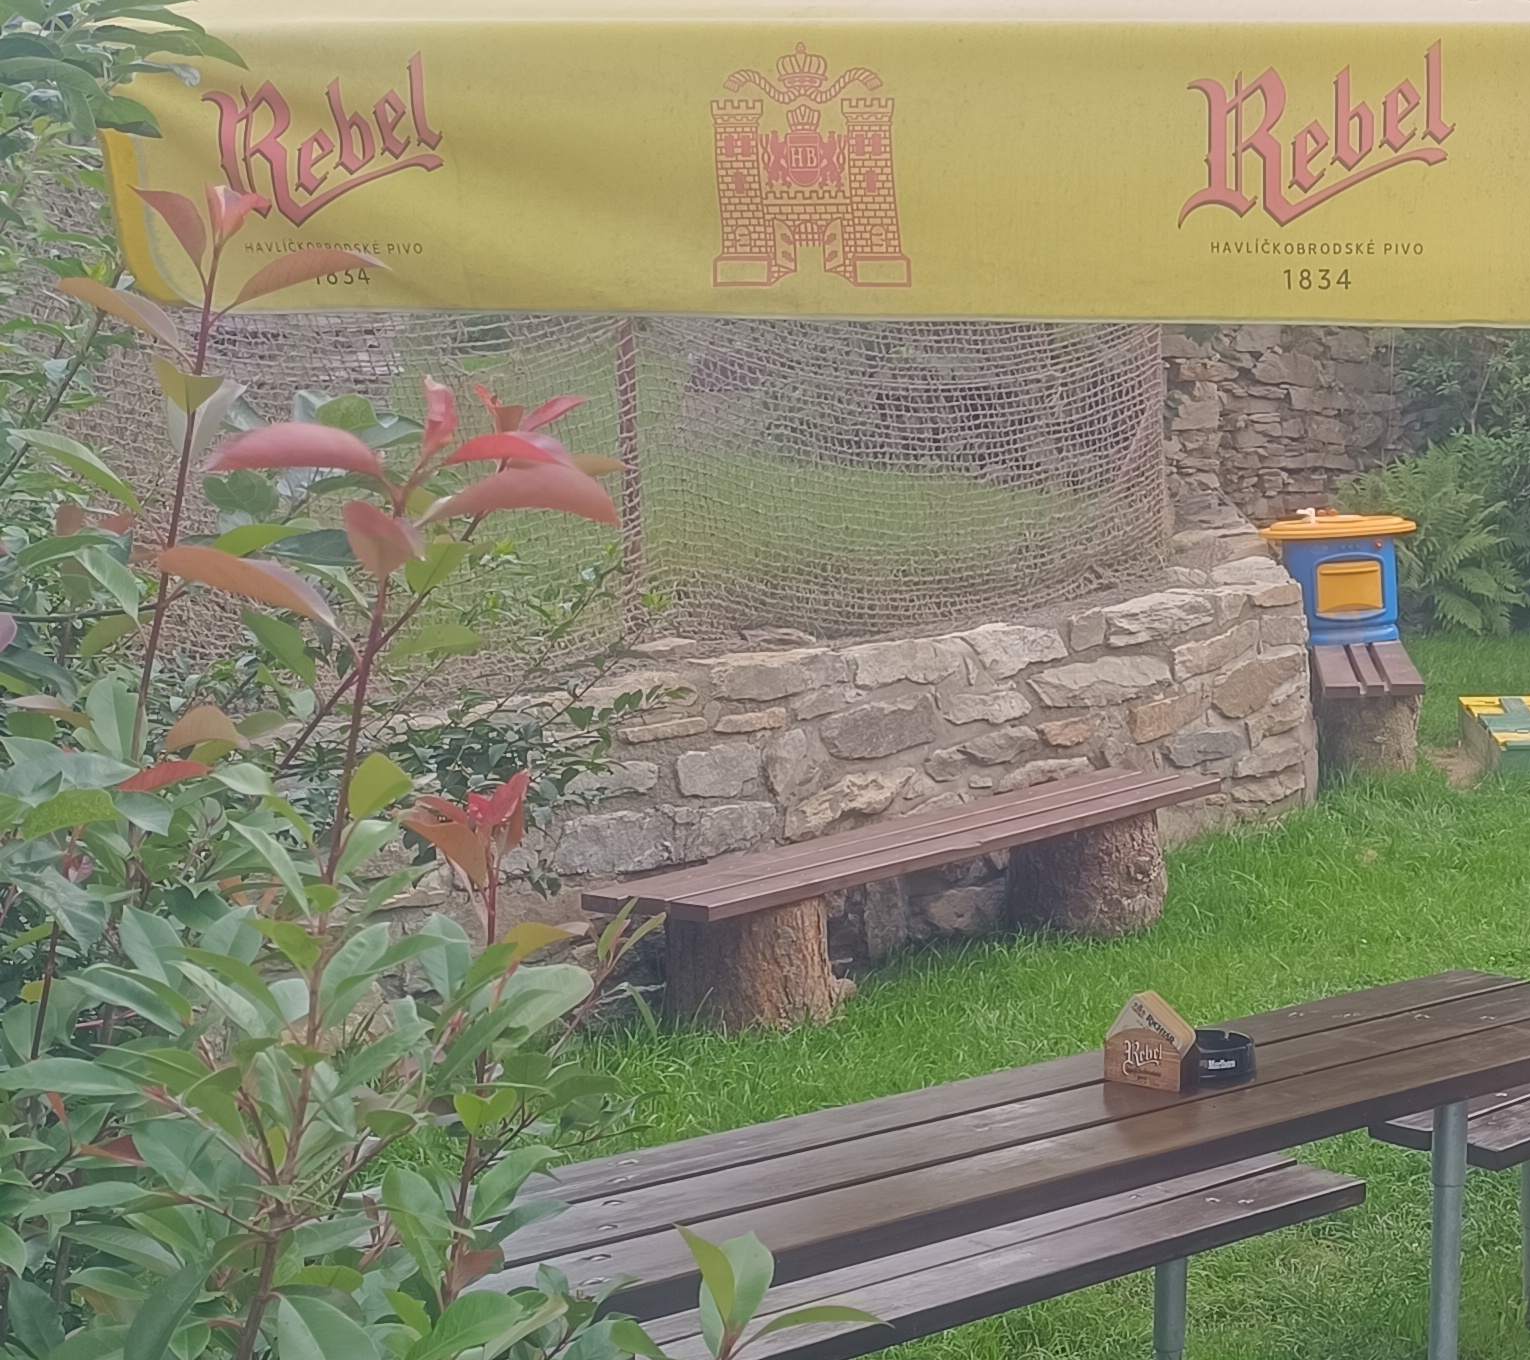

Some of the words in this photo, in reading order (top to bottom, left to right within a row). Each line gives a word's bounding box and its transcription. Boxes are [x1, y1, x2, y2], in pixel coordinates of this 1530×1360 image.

[200, 50, 444, 228] Rebel
[1177, 39, 1457, 228] Rebel
[387, 242, 423, 255] PIVO
[1210, 238, 1376, 256] HAVLÍČKOBRODSKÉ
[1383, 242, 1424, 256] PIVO
[1283, 268, 1352, 291] 1834
[1123, 1040, 1163, 1076] Rebel
